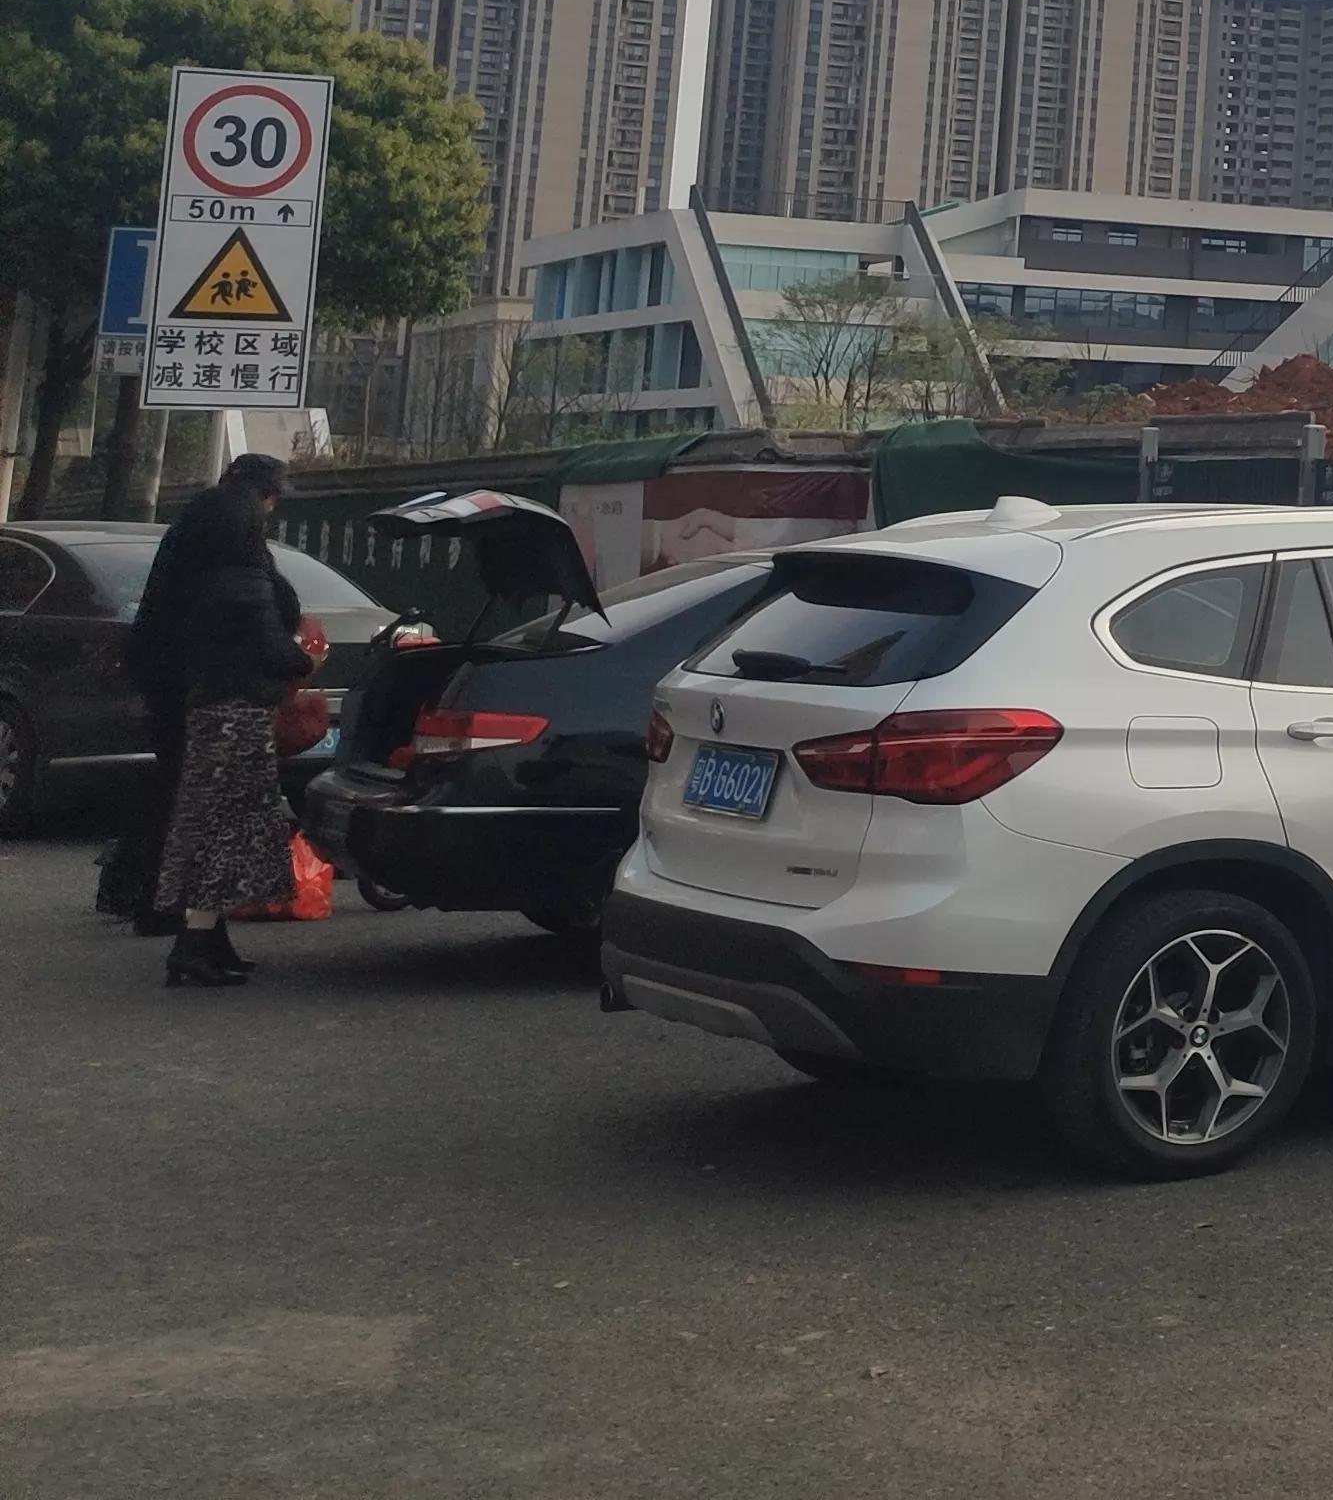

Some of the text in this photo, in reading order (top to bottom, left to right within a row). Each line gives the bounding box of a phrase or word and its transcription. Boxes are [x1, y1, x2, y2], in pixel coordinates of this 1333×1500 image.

[210, 116, 287, 169] 30
[188, 200, 255, 222] 50m
[156, 329, 299, 357] 学校区域
[153, 362, 298, 390] 减速慢行
